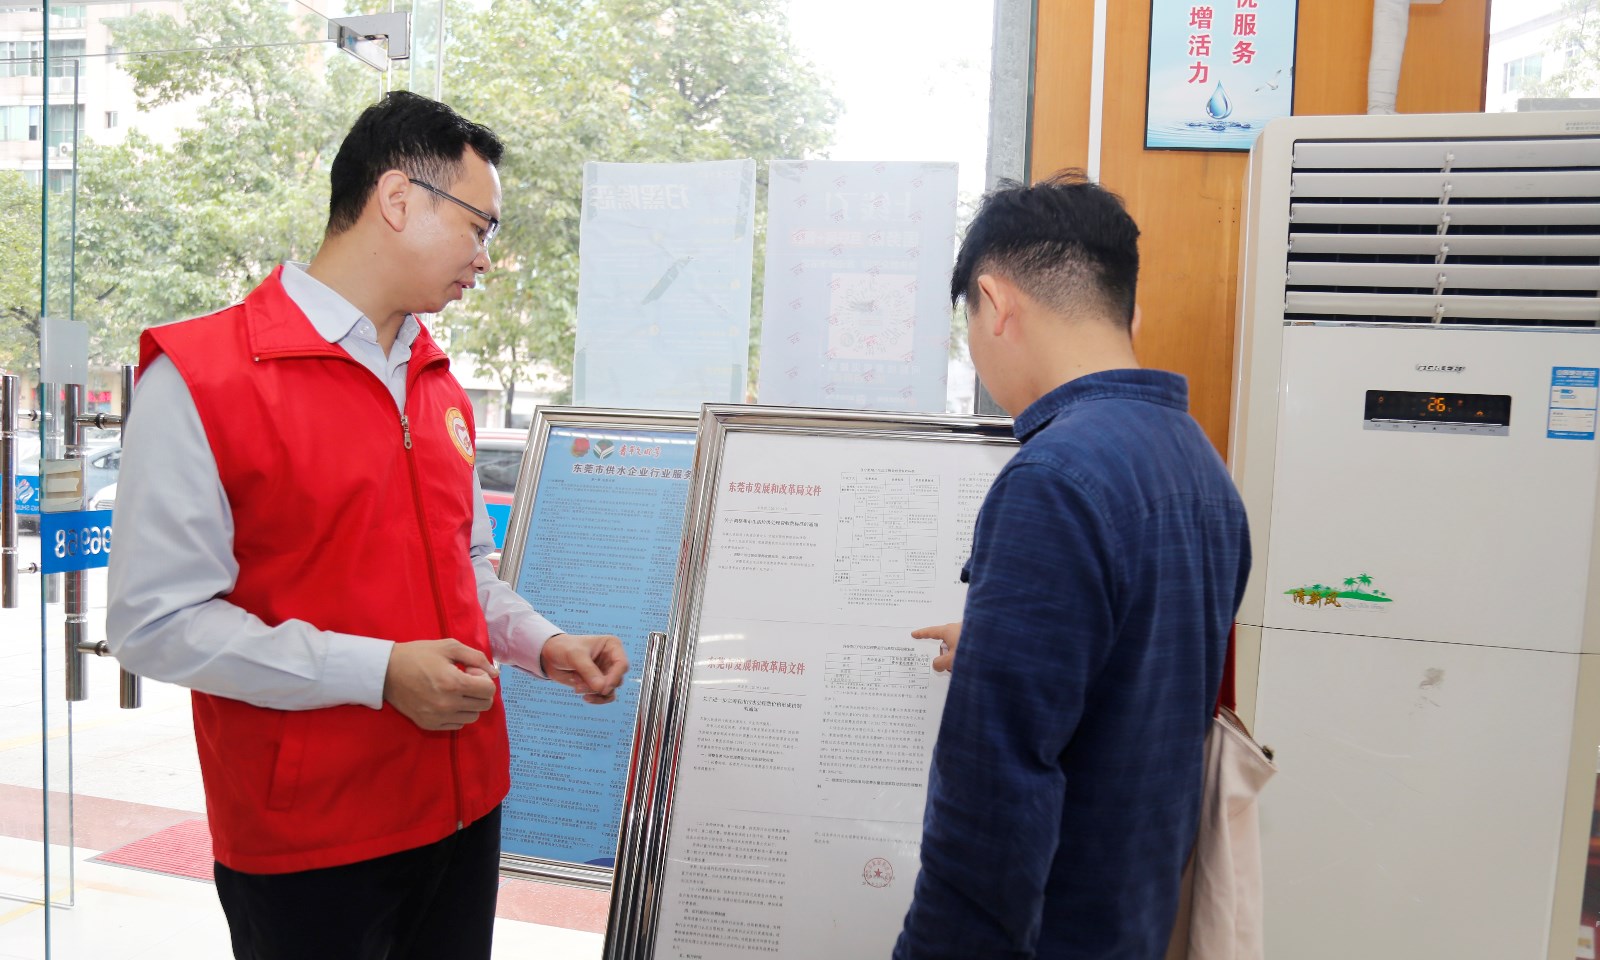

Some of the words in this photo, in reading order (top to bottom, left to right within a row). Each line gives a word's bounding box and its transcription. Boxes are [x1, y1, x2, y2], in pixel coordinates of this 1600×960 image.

[1188, 6, 1213, 84] 增活力
[1427, 397, 1446, 412] 26
[728, 481, 822, 497] 东莞市发展和改革局文件
